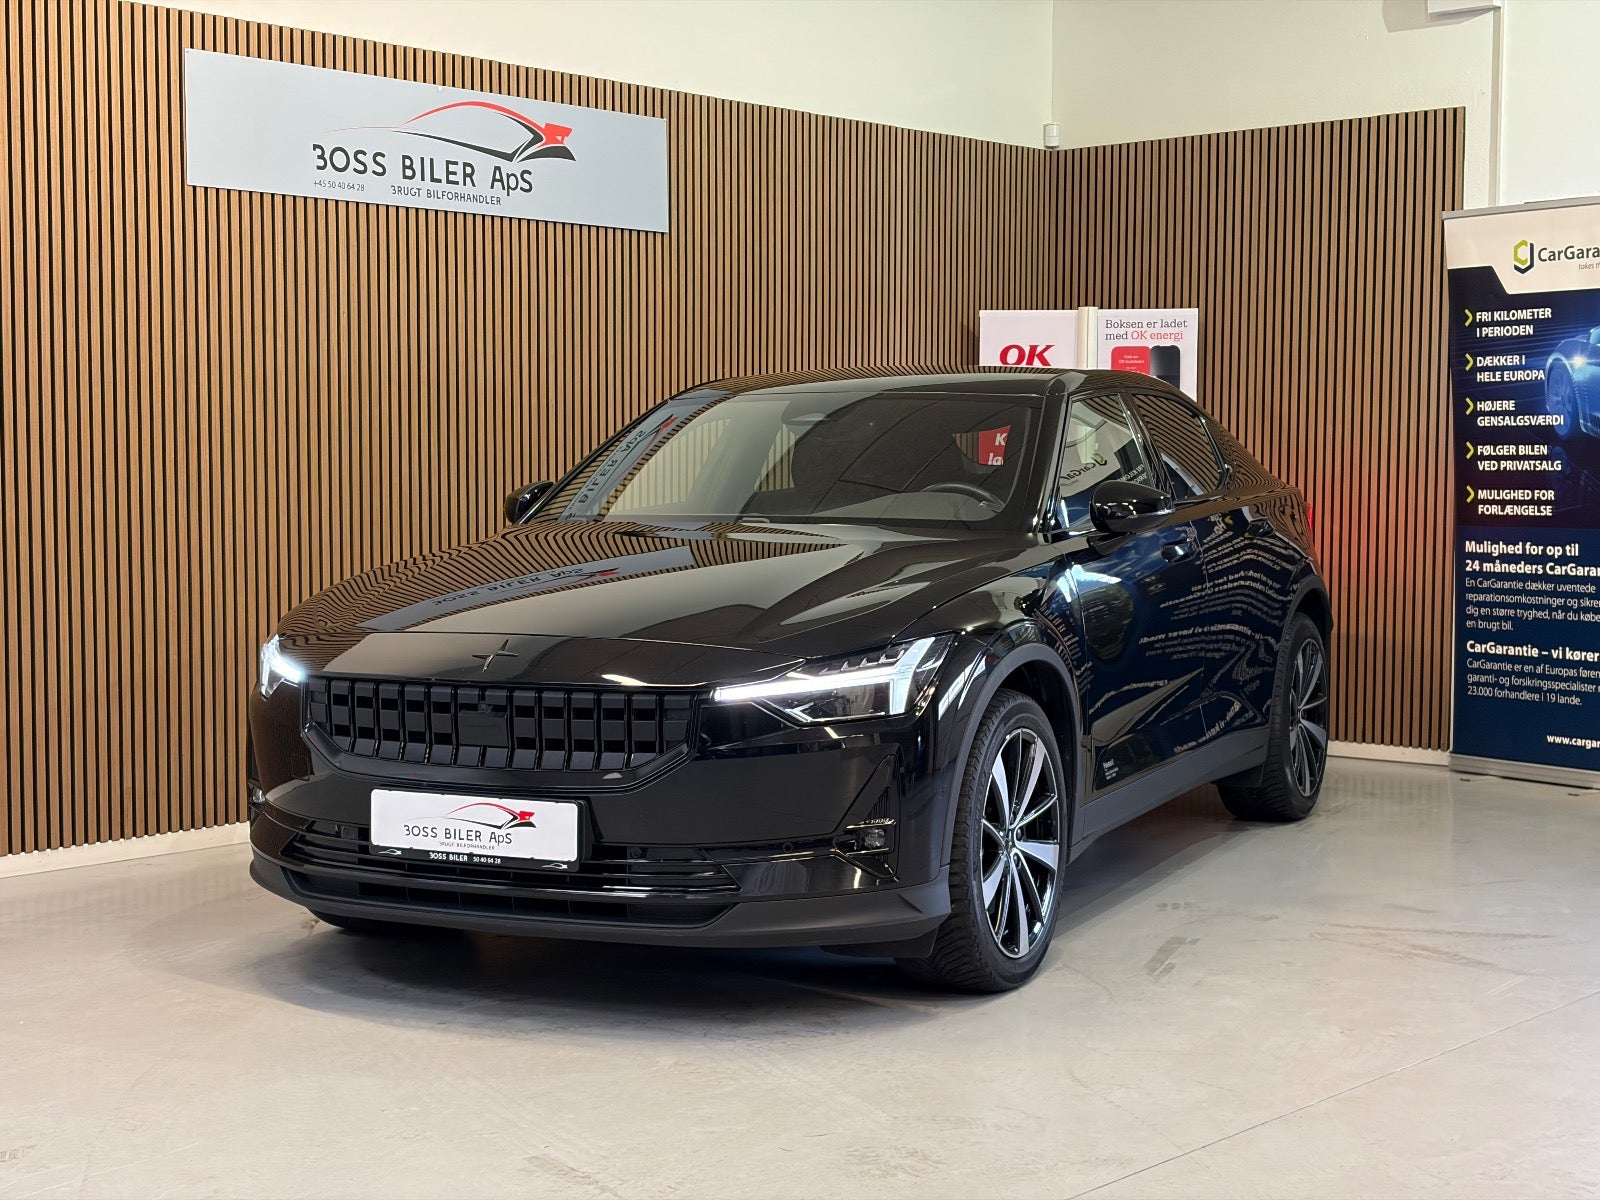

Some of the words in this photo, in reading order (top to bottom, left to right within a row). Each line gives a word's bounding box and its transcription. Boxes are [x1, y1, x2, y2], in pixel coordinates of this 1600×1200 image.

[402, 154, 476, 187] BILER
[490, 166, 533, 197] ApS
[314, 179, 326, 188] +45
[347, 182, 355, 190] 64
[357, 183, 365, 192] 28
[427, 189, 501, 205] BILFORHANDLER
[1538, 245, 1600, 262] CarGara
[1579, 262, 1594, 270] takes
[1476, 312, 1491, 322] FRI
[1494, 308, 1552, 322] KILOMETER
[1105, 319, 1144, 329] Boksen
[1146, 320, 1158, 328] er
[1160, 318, 1188, 328] ladet
[1105, 331, 1128, 340] med
[1131, 330, 1148, 340] OK
[1150, 331, 1184, 342] energi
[1482, 325, 1533, 337] PERIODEN
[999, 344, 1055, 366] OK
[1476, 356, 1520, 367] DÆKKER
[1477, 371, 1501, 382] HELE
[1504, 370, 1545, 381] EUROPA
[1477, 400, 1516, 412] HØJERE
[1477, 415, 1564, 426] GENSALGSVÆRDI
[995, 432, 1008, 446] K
[1477, 445, 1516, 456] FØLGER
[1519, 445, 1548, 455] BILEN
[988, 452, 1004, 466] la
[1477, 460, 1498, 470] VED
[1500, 460, 1562, 471] PRIVATSALG
[1478, 489, 1532, 500] MULIGHED
[1534, 490, 1555, 500] FOR
[1478, 504, 1552, 516] FORLÆNGELSE
[1465, 540, 1522, 556] Mulighed
[1525, 542, 1542, 555] for
[1546, 545, 1563, 558] op
[1566, 543, 1579, 556] til
[1465, 560, 1480, 572] 24
[1482, 560, 1543, 574] måneders
[1465, 577, 1475, 587] En
[1477, 578, 1524, 590] CarGarantie
[1525, 580, 1555, 590] dækker
[1557, 583, 1596, 593] uventede
[1466, 593, 1565, 607] reparationsomkostninger
[1567, 598, 1578, 608] og
[1466, 605, 1478, 617] dig
[1480, 607, 1491, 615] en
[1492, 606, 1515, 617] større
[1517, 607, 1550, 620] tryghed,
[1552, 610, 1565, 619] når
[1567, 611, 1578, 620] du
[1466, 620, 1476, 628] en
[1478, 620, 1500, 631] brugt
[1501, 621, 1514, 631] bil.
[1466, 640, 1539, 657] CarGarantie
[1551, 647, 1563, 660] vi
[1566, 647, 1600, 662] kører
[1467, 658, 1512, 671] CarGarantie
[1514, 664, 1522, 672] er
[1524, 665, 1534, 673] en
[1536, 664, 1544, 674] af
[1545, 665, 1577, 677] Europas
[1467, 674, 1498, 683] garanti-
[1499, 676, 1509, 687] og
[1511, 675, 1596, 692] forsikringsspecialister
[1468, 686, 1493, 696] 23.000
[1494, 688, 1540, 701] forhandlere
[1546, 693, 1556, 702] 19
[1557, 694, 1582, 705] lande.
[444, 828, 482, 842] BILER
[489, 831, 512, 846] ApS
[449, 853, 468, 862] BILER
